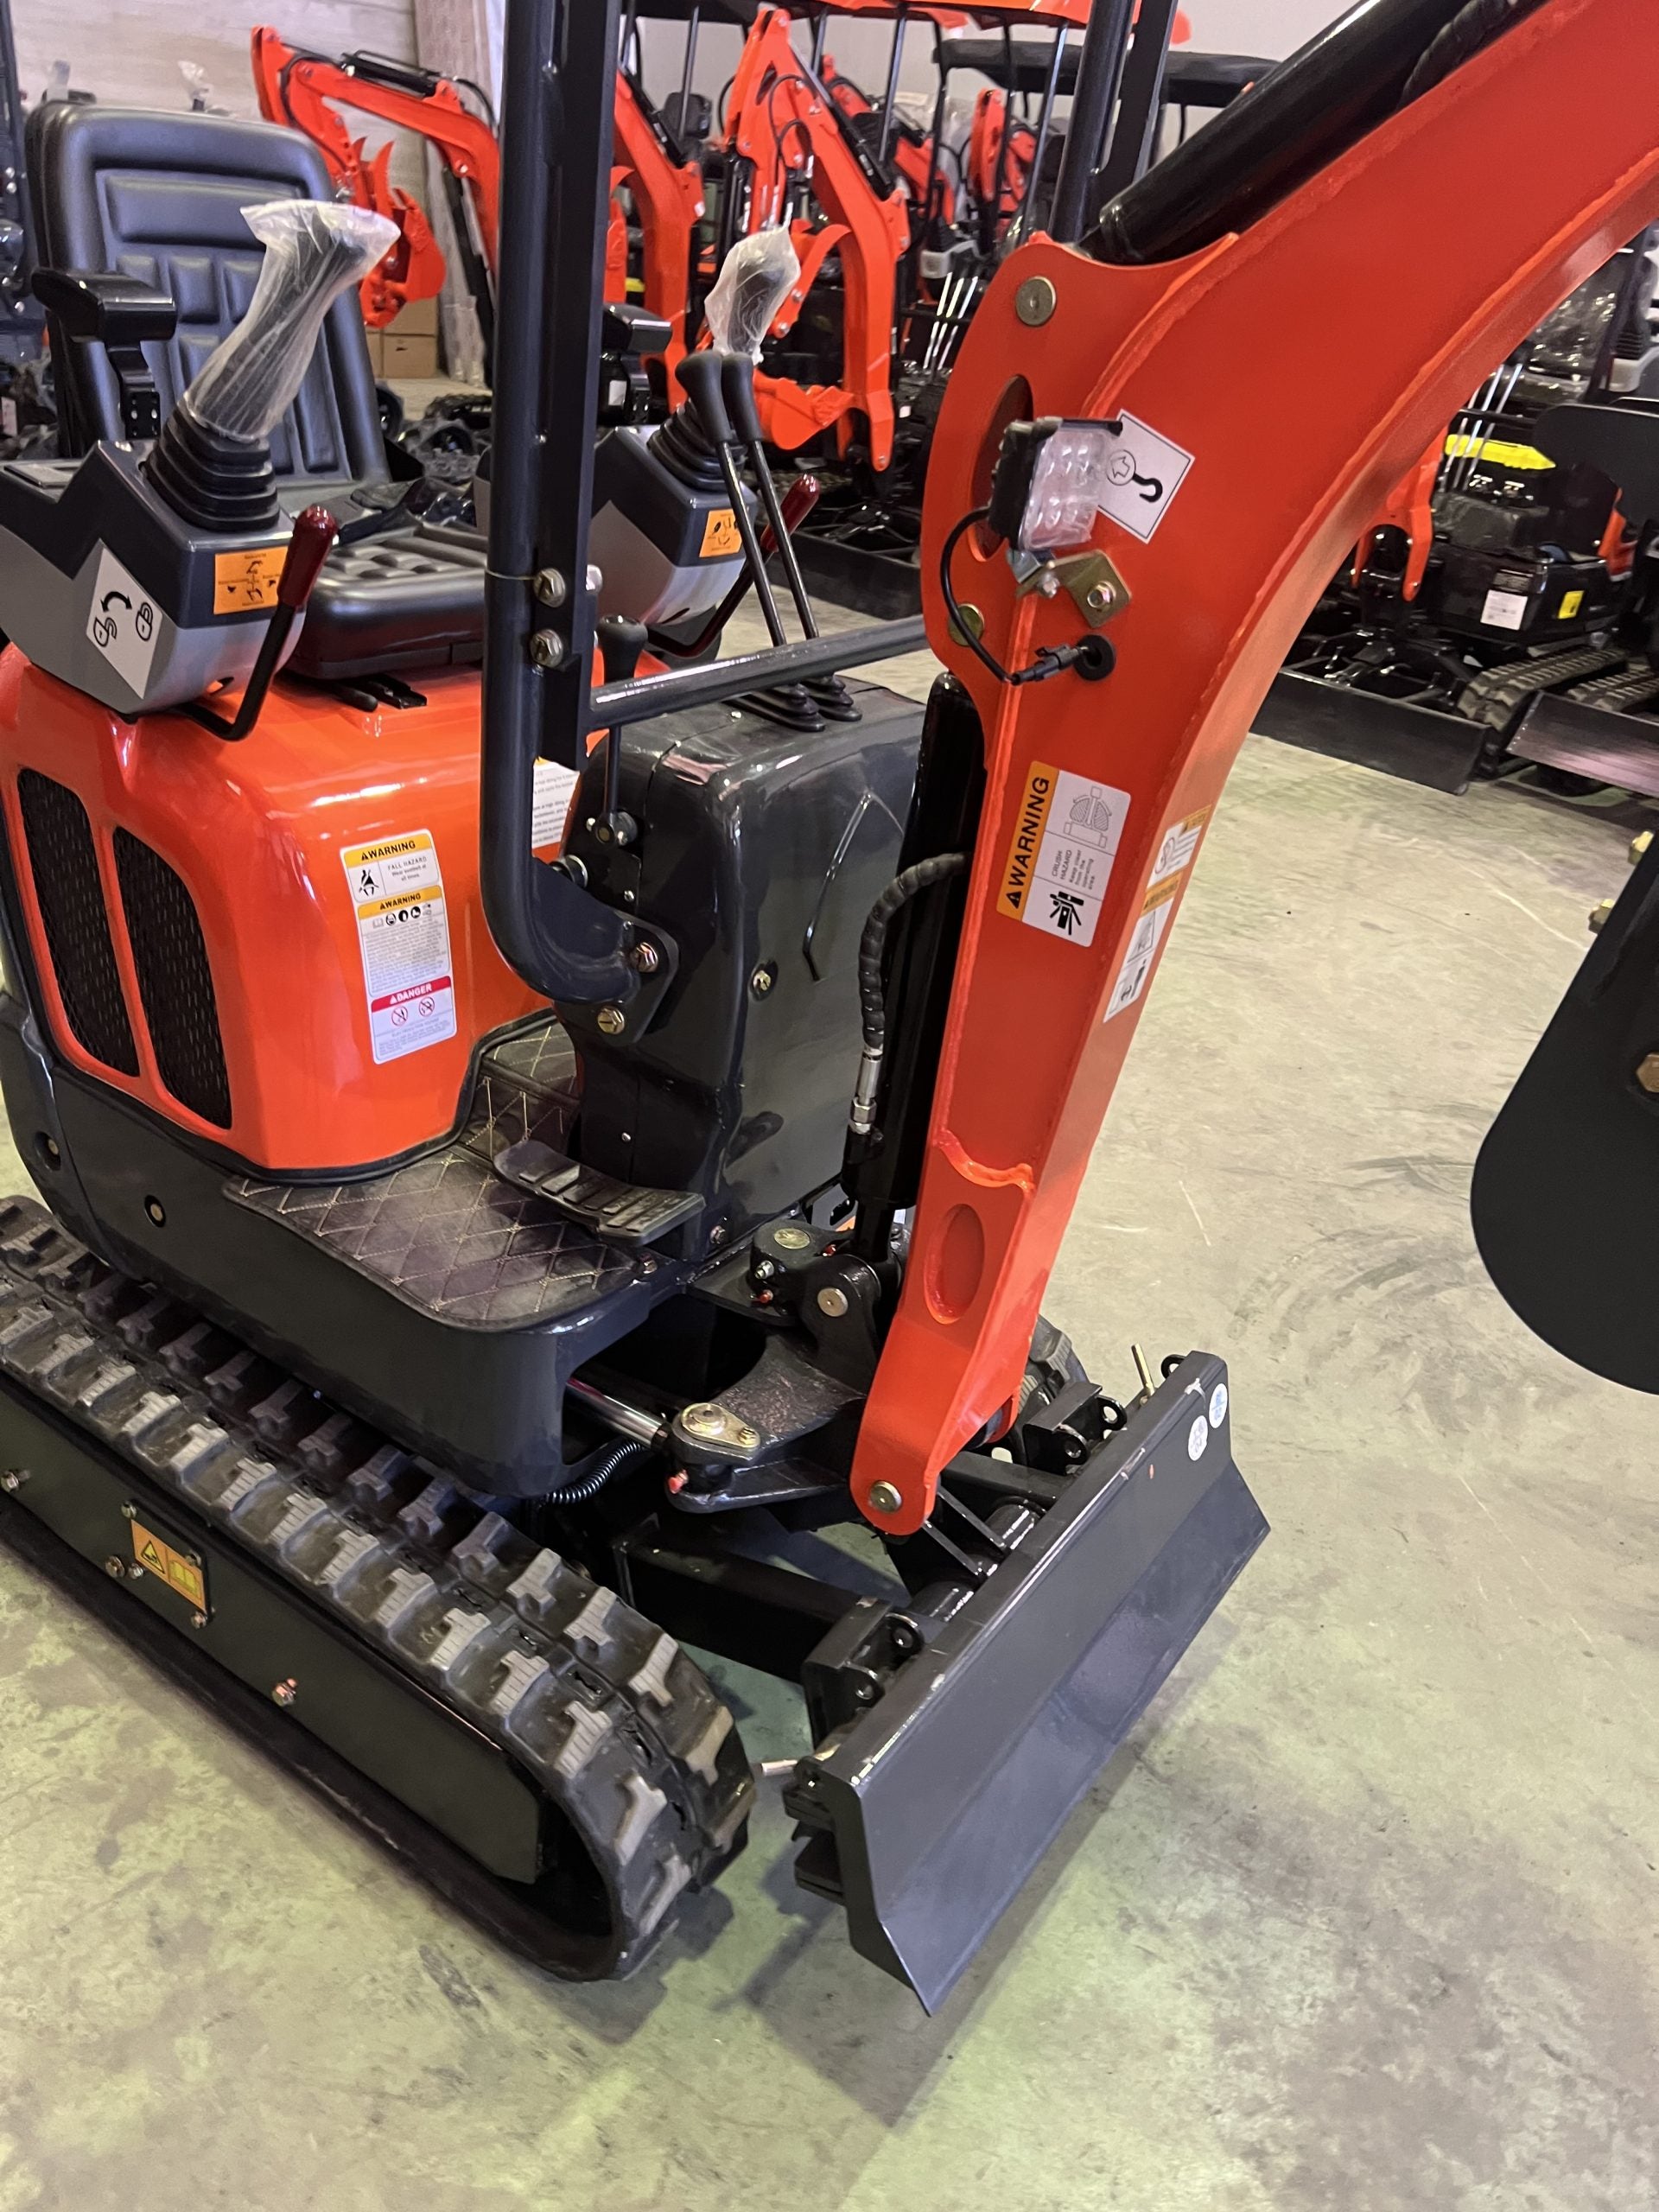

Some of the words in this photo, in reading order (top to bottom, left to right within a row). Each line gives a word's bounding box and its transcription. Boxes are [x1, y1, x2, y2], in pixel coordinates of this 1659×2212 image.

[1008, 777, 1049, 886] WARNING
[368, 840, 416, 859] WARNING
[403, 856, 427, 867] HAZARD
[1052, 850, 1063, 876] CRUSH
[1060, 849, 1072, 880] HAZARD
[385, 893, 421, 907] WARNING
[397, 982, 432, 1001] DANGER
